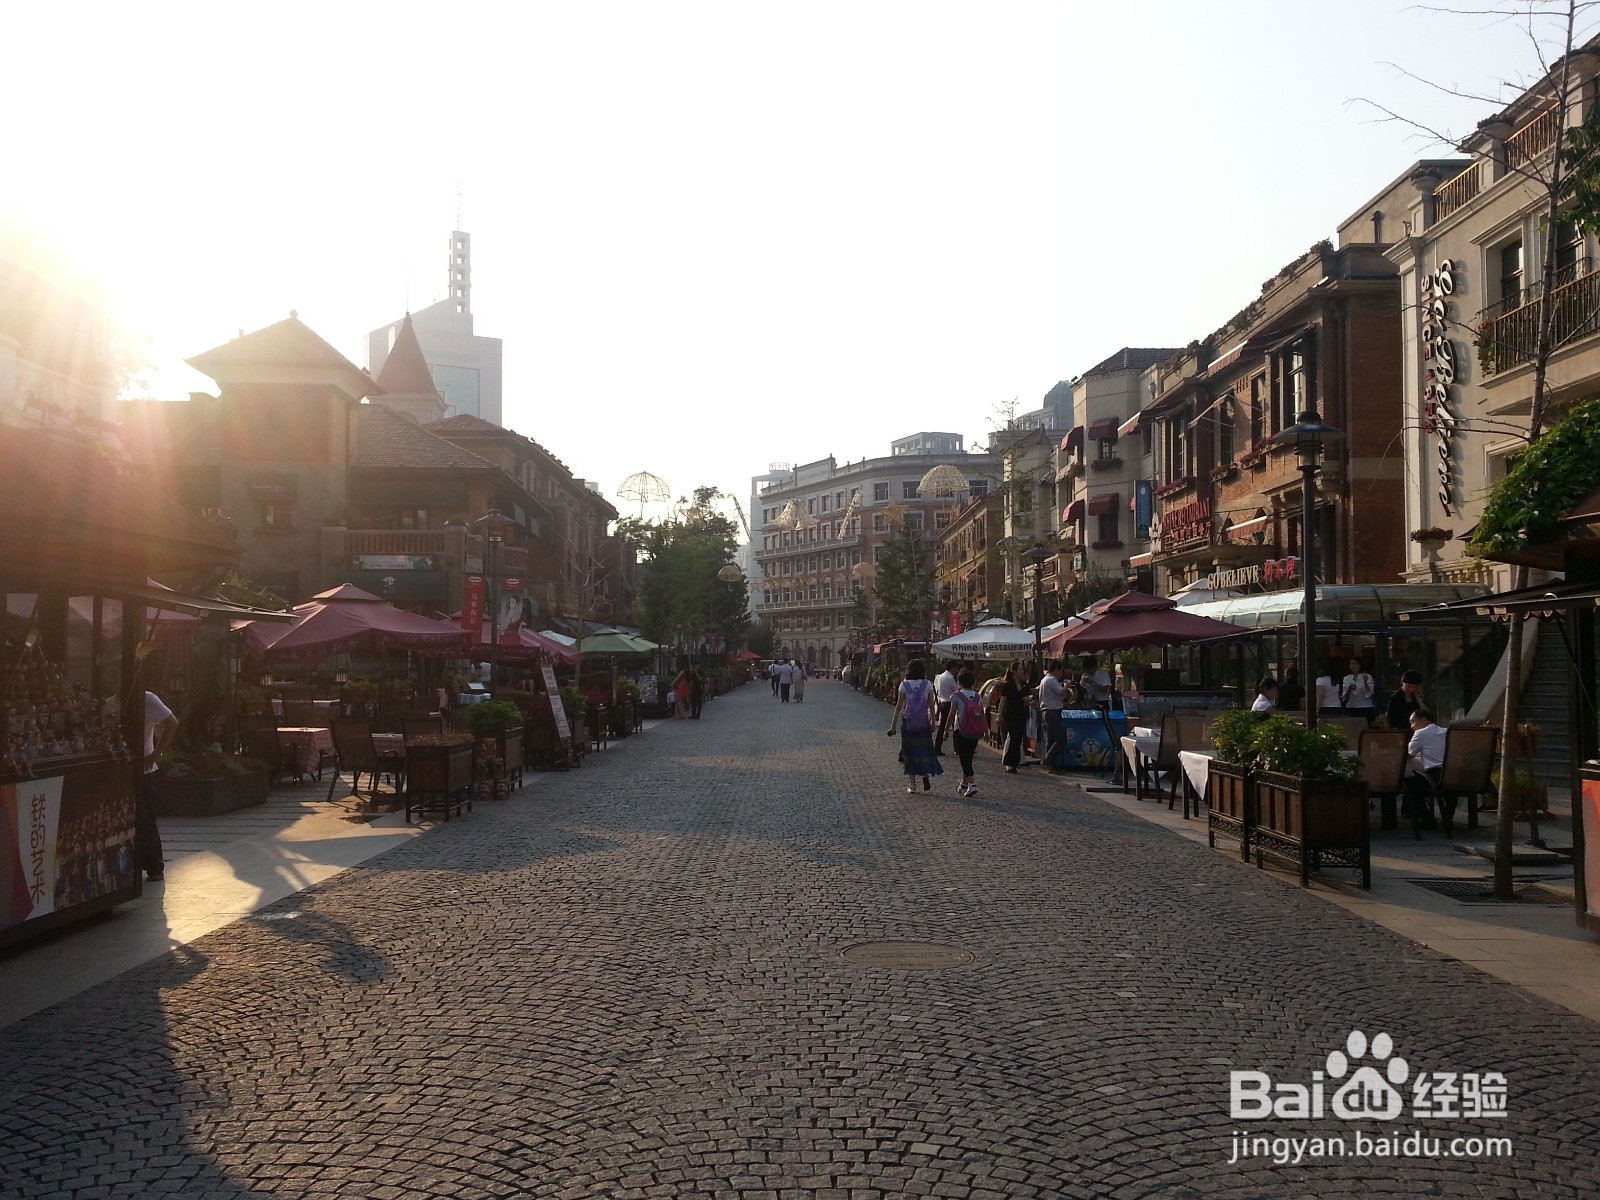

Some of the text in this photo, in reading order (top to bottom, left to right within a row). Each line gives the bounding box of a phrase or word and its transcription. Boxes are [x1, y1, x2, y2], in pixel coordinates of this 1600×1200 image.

[1421, 274, 1434, 362] SINCE
[952, 643, 1032, 652] Rhine Restaurant
